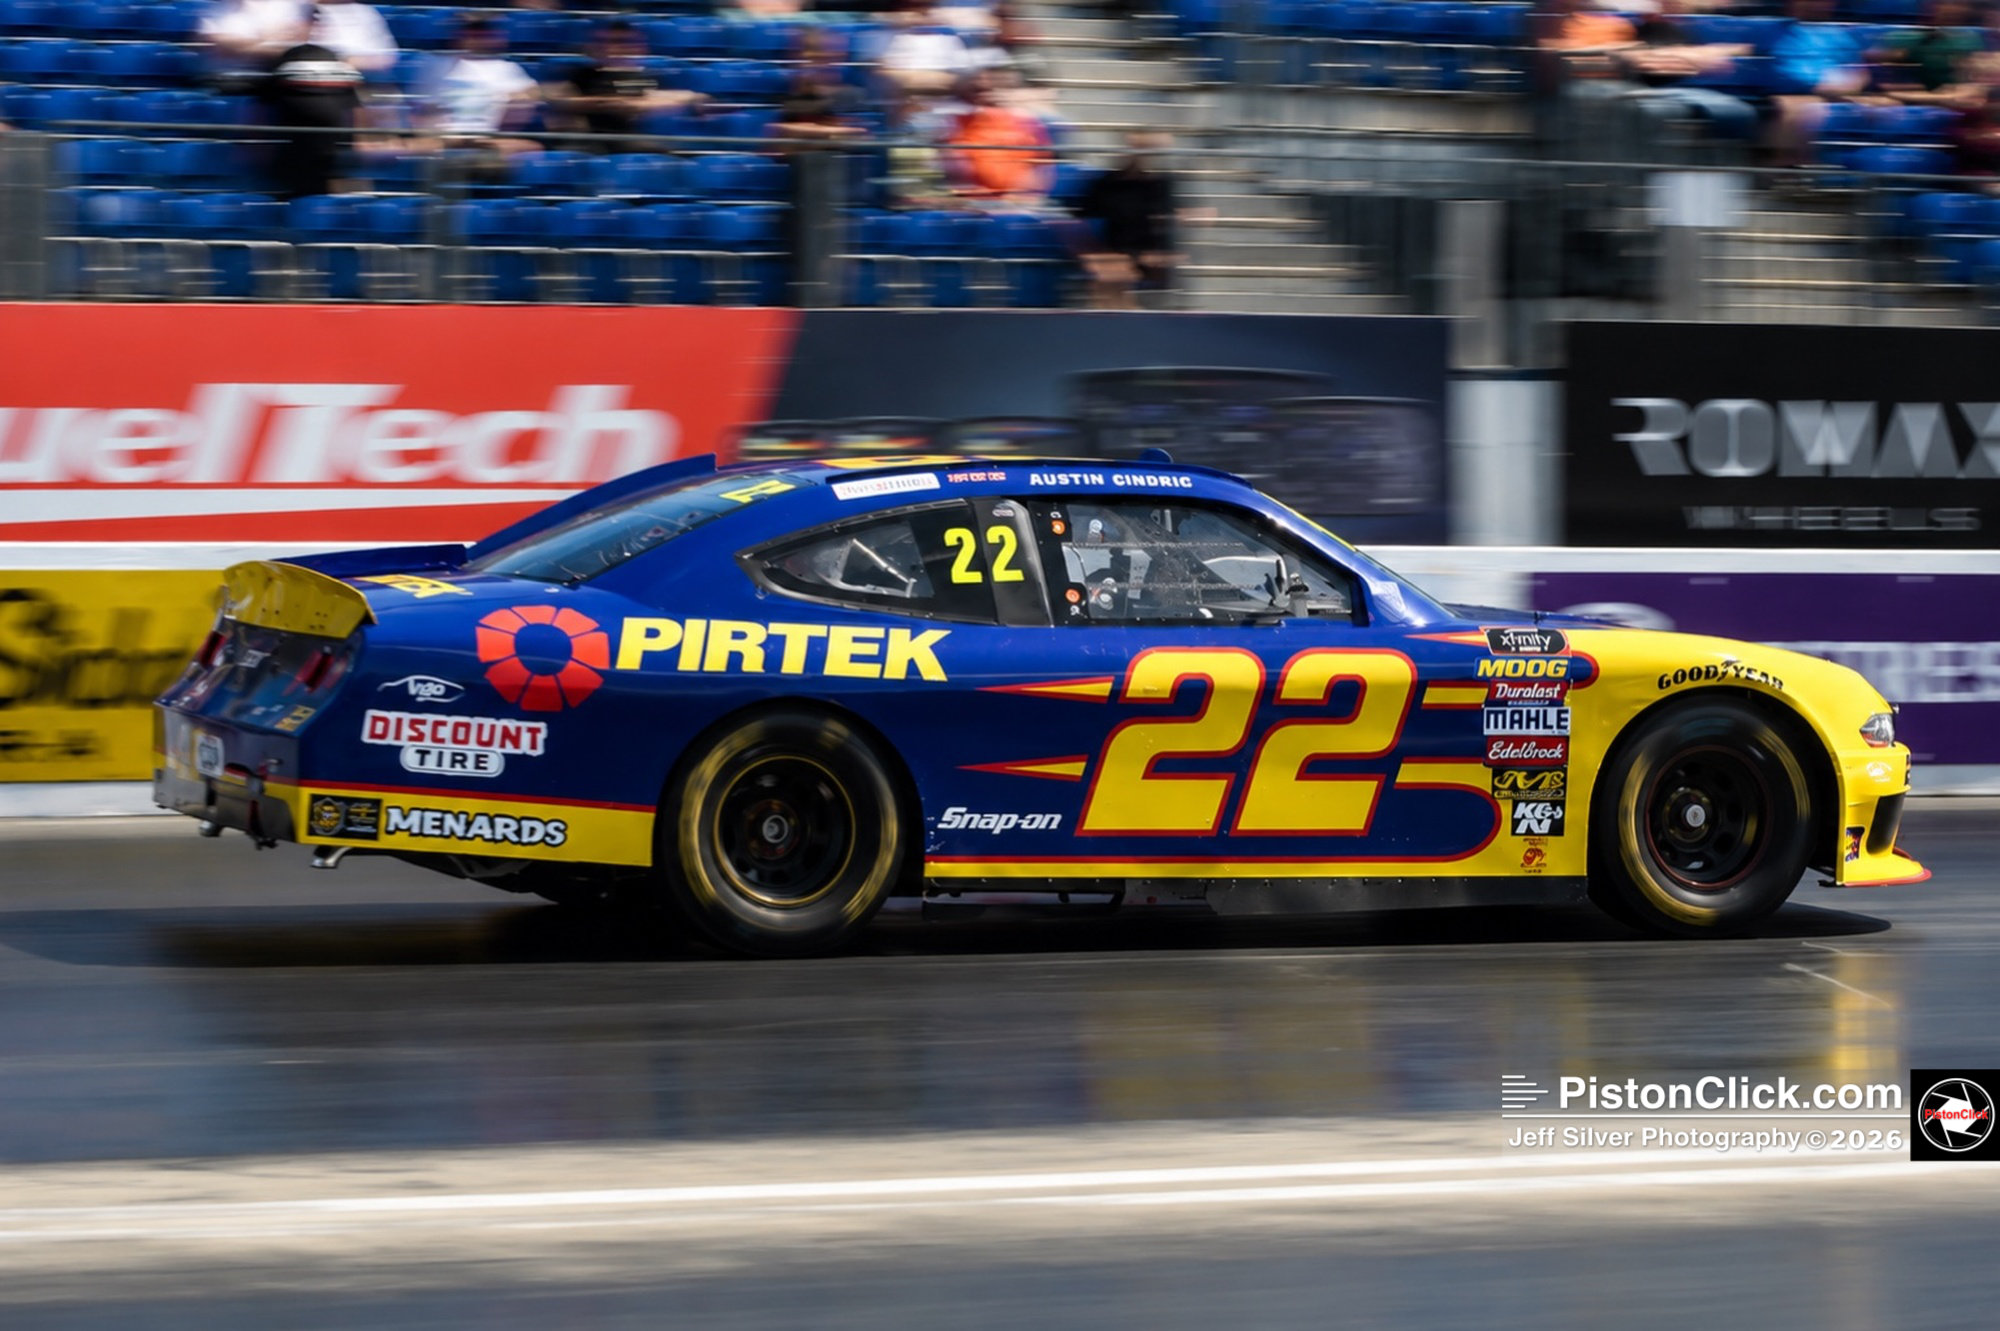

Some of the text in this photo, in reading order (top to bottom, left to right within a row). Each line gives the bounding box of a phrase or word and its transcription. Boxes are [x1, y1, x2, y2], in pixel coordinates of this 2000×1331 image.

[1029, 473, 1193, 488] AUSTIN CINDRIC
[943, 525, 1025, 584] 22
[615, 617, 952, 682] PIRTEK
[1477, 659, 1569, 678] MOOG
[1657, 659, 1784, 690] GOODYEAR
[368, 714, 543, 750] DISCOUNT
[1485, 708, 1569, 730] MAHLE
[1076, 645, 1418, 838] 22
[1488, 740, 1564, 760] Edelbrock
[414, 748, 489, 771] TIRE
[385, 806, 567, 847] MENARDS
[937, 806, 1062, 835] Snap-on
